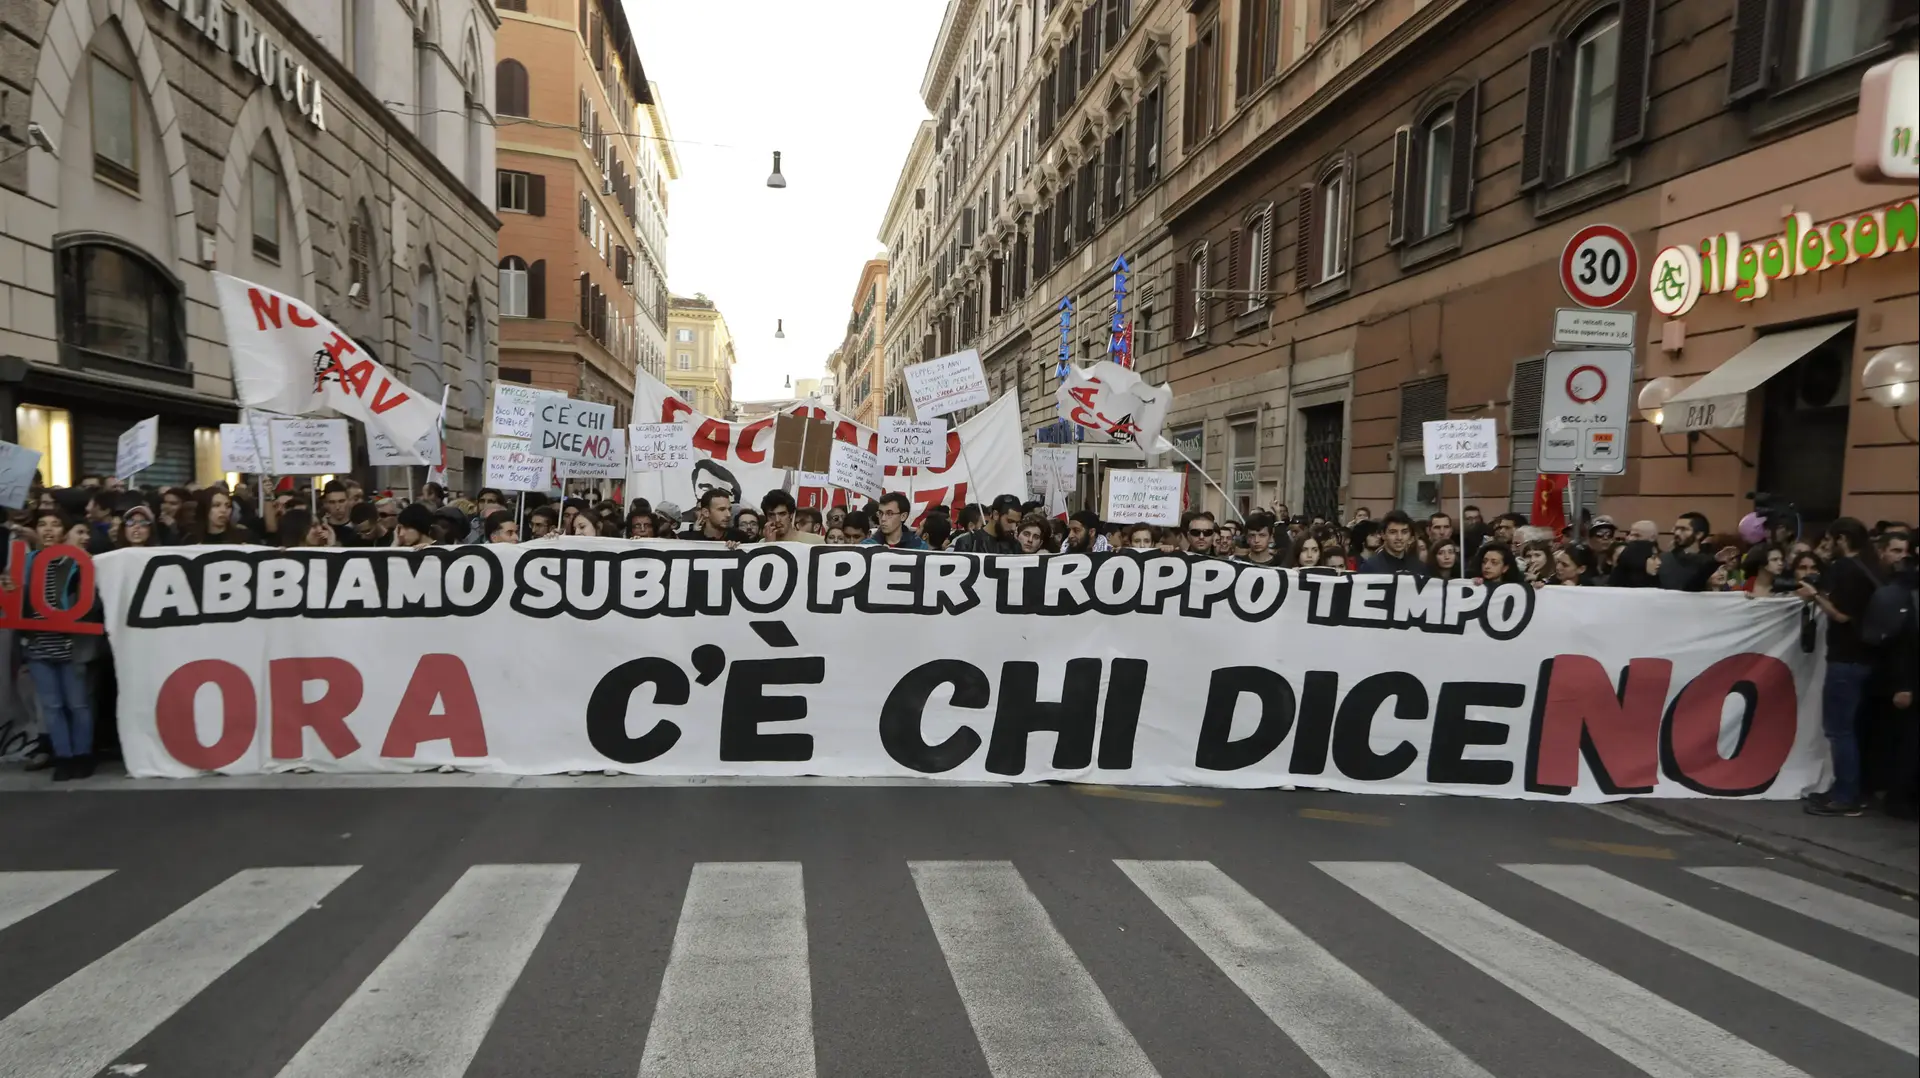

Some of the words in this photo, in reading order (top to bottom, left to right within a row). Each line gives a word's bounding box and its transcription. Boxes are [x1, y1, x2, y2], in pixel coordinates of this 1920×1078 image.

[236, 6, 326, 131] ROCCA
[1578, 247, 1622, 287] 30
[328, 330, 410, 414] TAV
[915, 395, 932, 403] RENZI
[513, 407, 526, 417] NO
[1685, 403, 1716, 428] BAR
[577, 411, 606, 431] CHI
[1561, 414, 1607, 423] eccto
[653, 440, 667, 452] NO
[884, 435, 899, 444] DICO
[904, 435, 919, 446] NO
[1456, 440, 1471, 451] NO
[885, 446, 910, 454] RIFORMA
[508, 452, 525, 464] NO
[635, 454, 643, 462] IL
[898, 455, 932, 465] BANCHE
[647, 461, 679, 469] POPOLO
[1113, 493, 1130, 502] VOTO
[1132, 491, 1147, 502] NO!
[131, 550, 501, 624] ABBIAMO
[514, 547, 792, 618] SUBITO
[810, 547, 978, 612] PER
[988, 550, 1285, 620] TROPPO
[1299, 570, 1532, 637] TEMPO
[156, 653, 488, 770] ORA
[586, 620, 826, 764] C'È
[879, 657, 1149, 777] CHI
